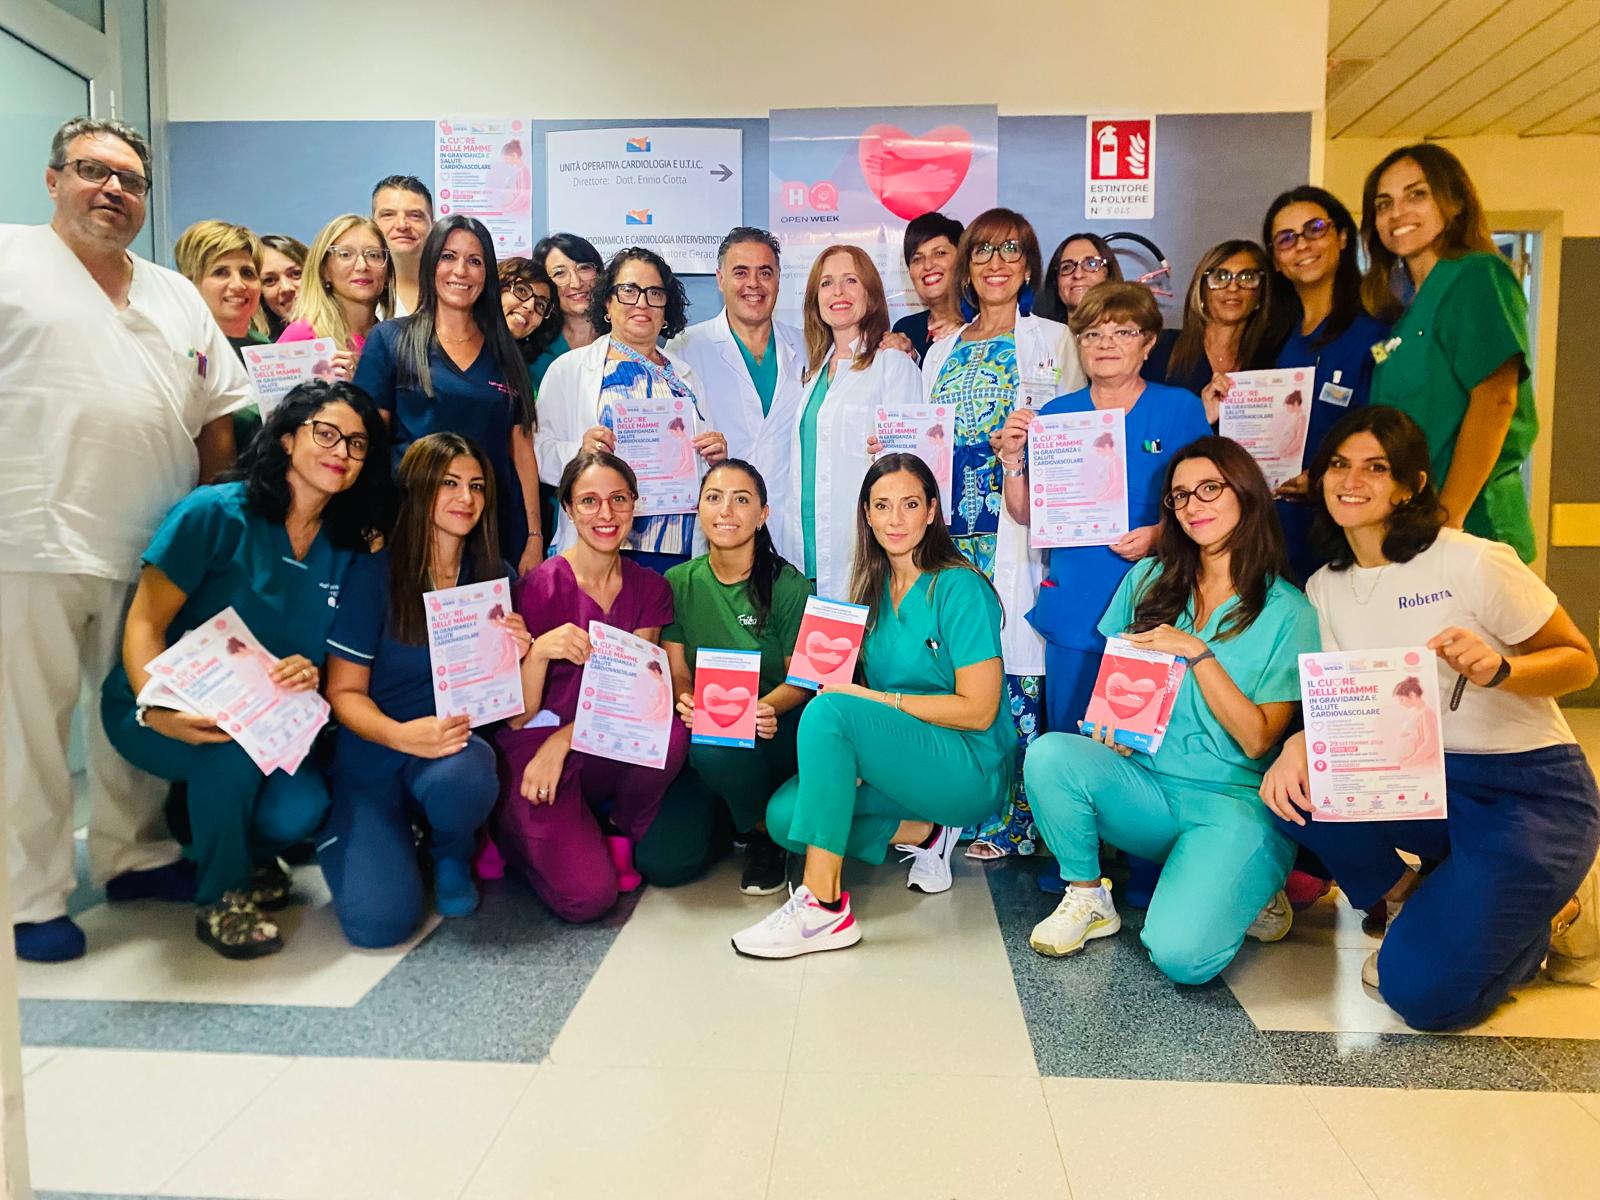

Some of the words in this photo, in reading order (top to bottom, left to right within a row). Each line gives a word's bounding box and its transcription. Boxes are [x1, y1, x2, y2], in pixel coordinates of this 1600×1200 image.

[560, 161, 581, 172] UNITÀ
[582, 160, 620, 171] OPERATIVA
[621, 160, 671, 169] CARDIOLOGIA
[673, 160, 678, 168] E
[680, 160, 703, 168] U.T.I.C.
[573, 177, 609, 187] Direttore:
[616, 175, 636, 184] Dott.
[638, 175, 660, 184] Ennio
[663, 175, 687, 184] Ciotta
[1091, 184, 1148, 192] ESTINTORE
[586, 236, 624, 245] ODINAMICA
[625, 236, 629, 244] E
[631, 235, 674, 244] CARDIOLOGIA
[676, 235, 727, 244] INTERVENTISTIC
[689, 249, 714, 258] Geraci
[1308, 680, 1314, 688] IL
[1308, 688, 1337, 696] DELLE
[1340, 685, 1379, 695] MAMME
[1319, 695, 1370, 704] GRAVIDANZA
[1310, 704, 1339, 712] SALUTE
[1310, 709, 1380, 718] CARDIOVASCOLARE
